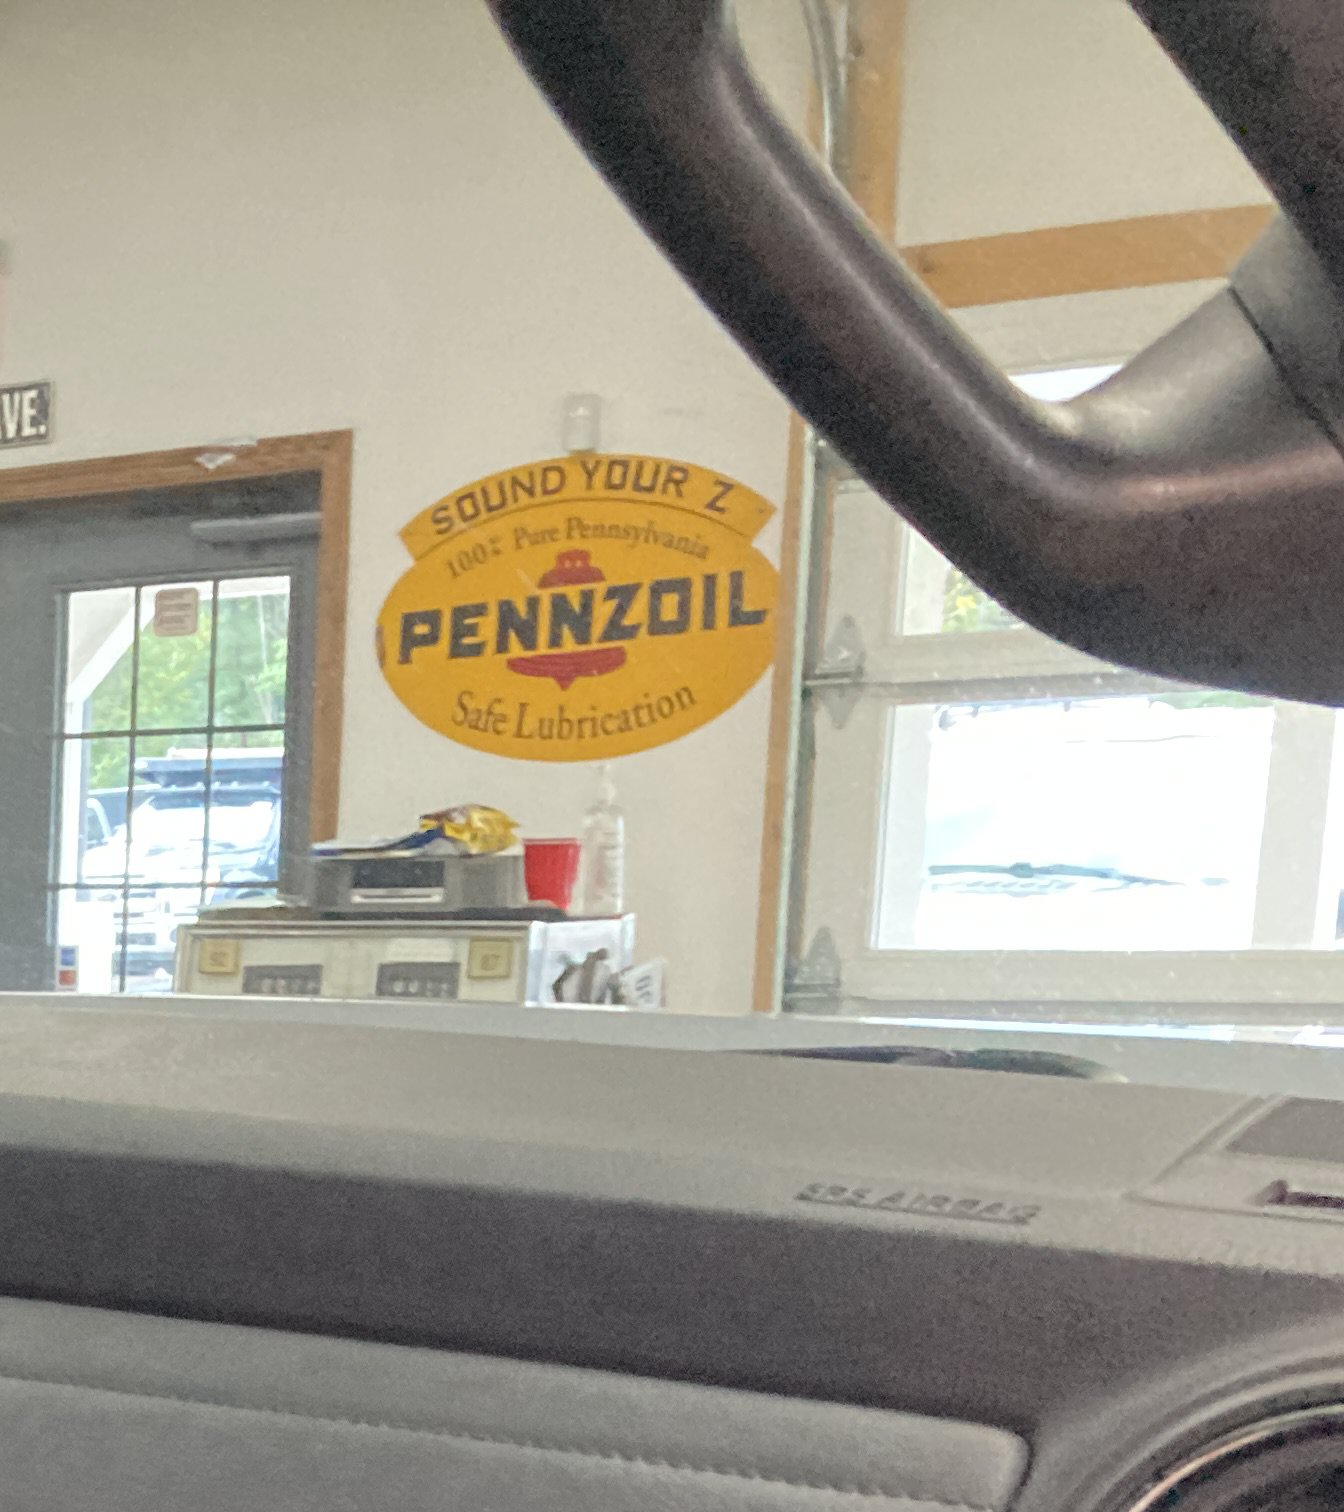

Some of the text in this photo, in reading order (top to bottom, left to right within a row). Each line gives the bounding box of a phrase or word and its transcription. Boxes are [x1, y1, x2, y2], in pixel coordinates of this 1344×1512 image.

[431, 460, 734, 536] SOUND YOUR Z
[513, 527, 560, 550] Pure
[566, 516, 711, 560] Pennsylvania
[397, 570, 771, 664] PENNZOIL
[452, 686, 697, 740] Safe Lubrication
